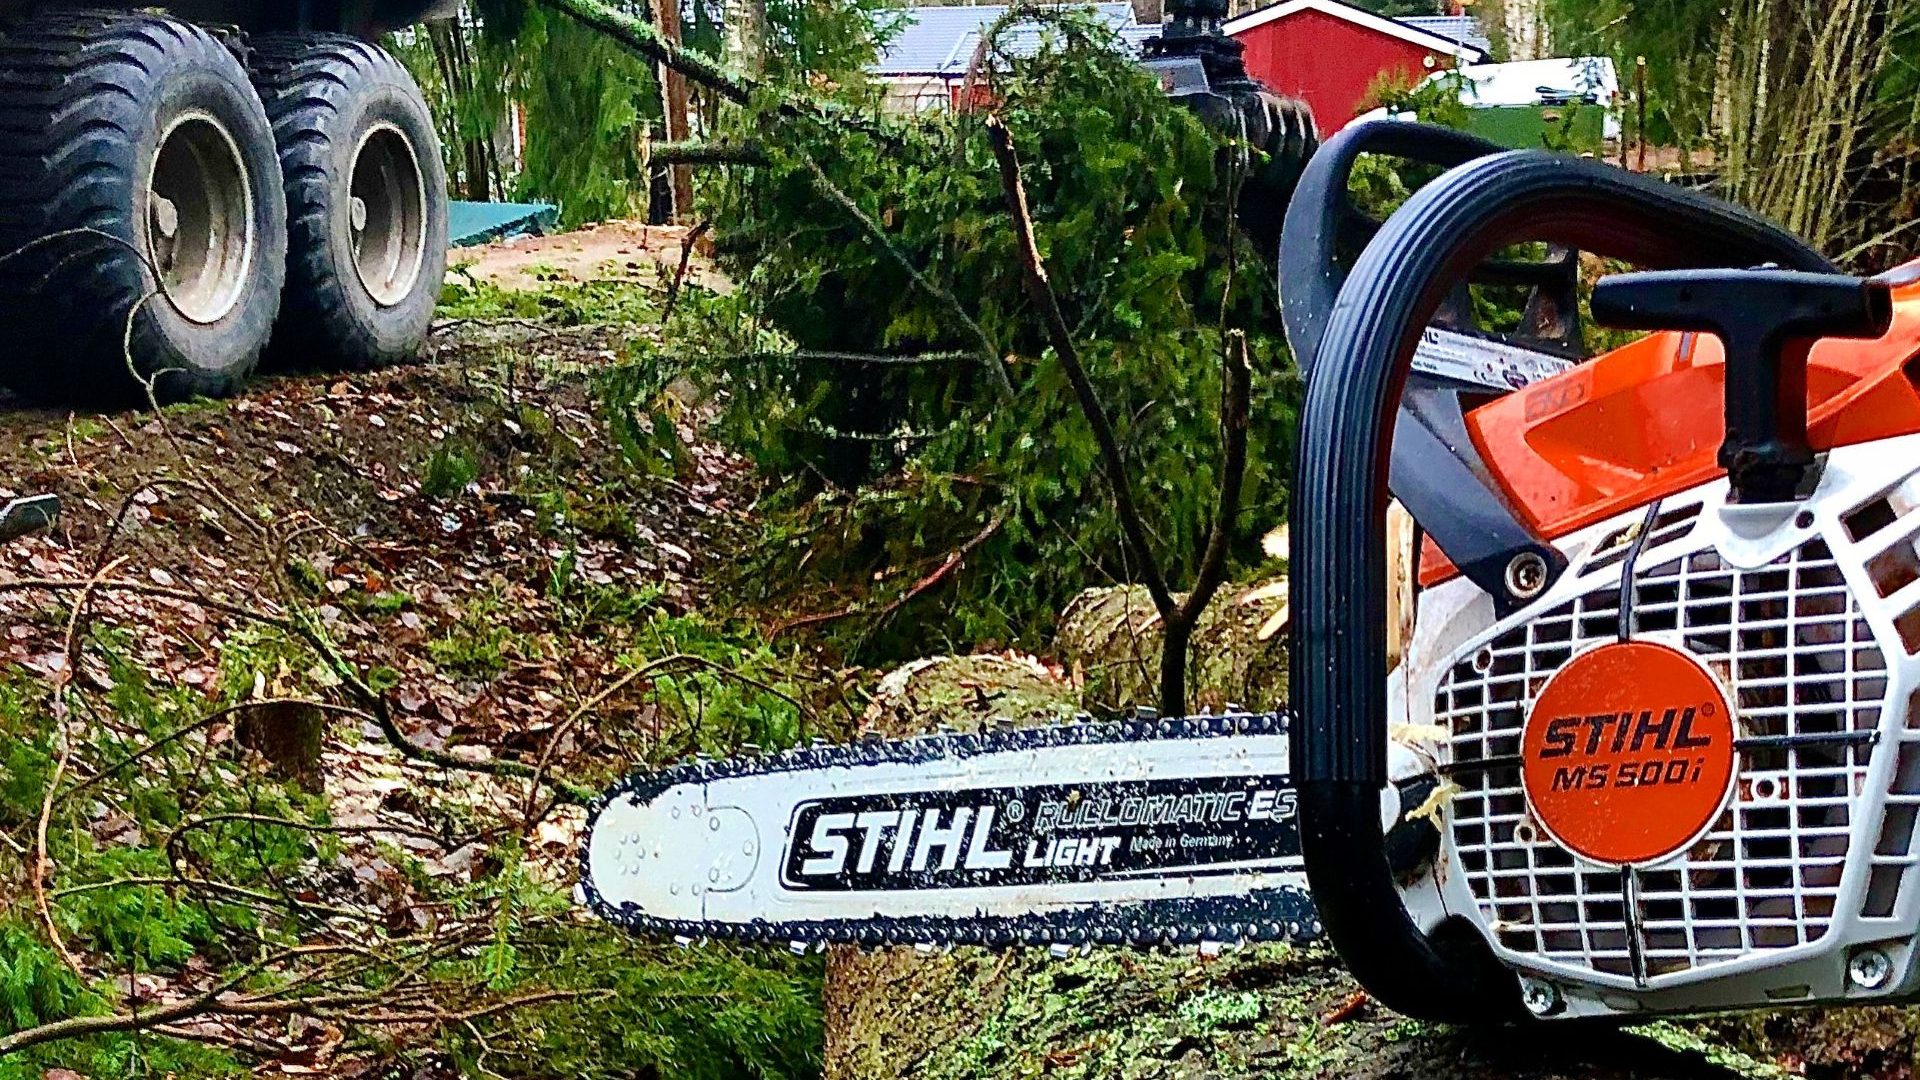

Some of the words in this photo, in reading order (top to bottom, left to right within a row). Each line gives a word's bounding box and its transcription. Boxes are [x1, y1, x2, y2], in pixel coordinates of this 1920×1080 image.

[1551, 763, 1611, 792] MS
[1614, 757, 1705, 789] 500i
[1034, 791, 1247, 829] ROLLOMATIC
[1249, 788, 1298, 823] ES
[1022, 836, 1122, 868] LIGHT
[1129, 835, 1163, 852] Made
[1165, 835, 1177, 848] in
[1180, 832, 1234, 849] Germany
